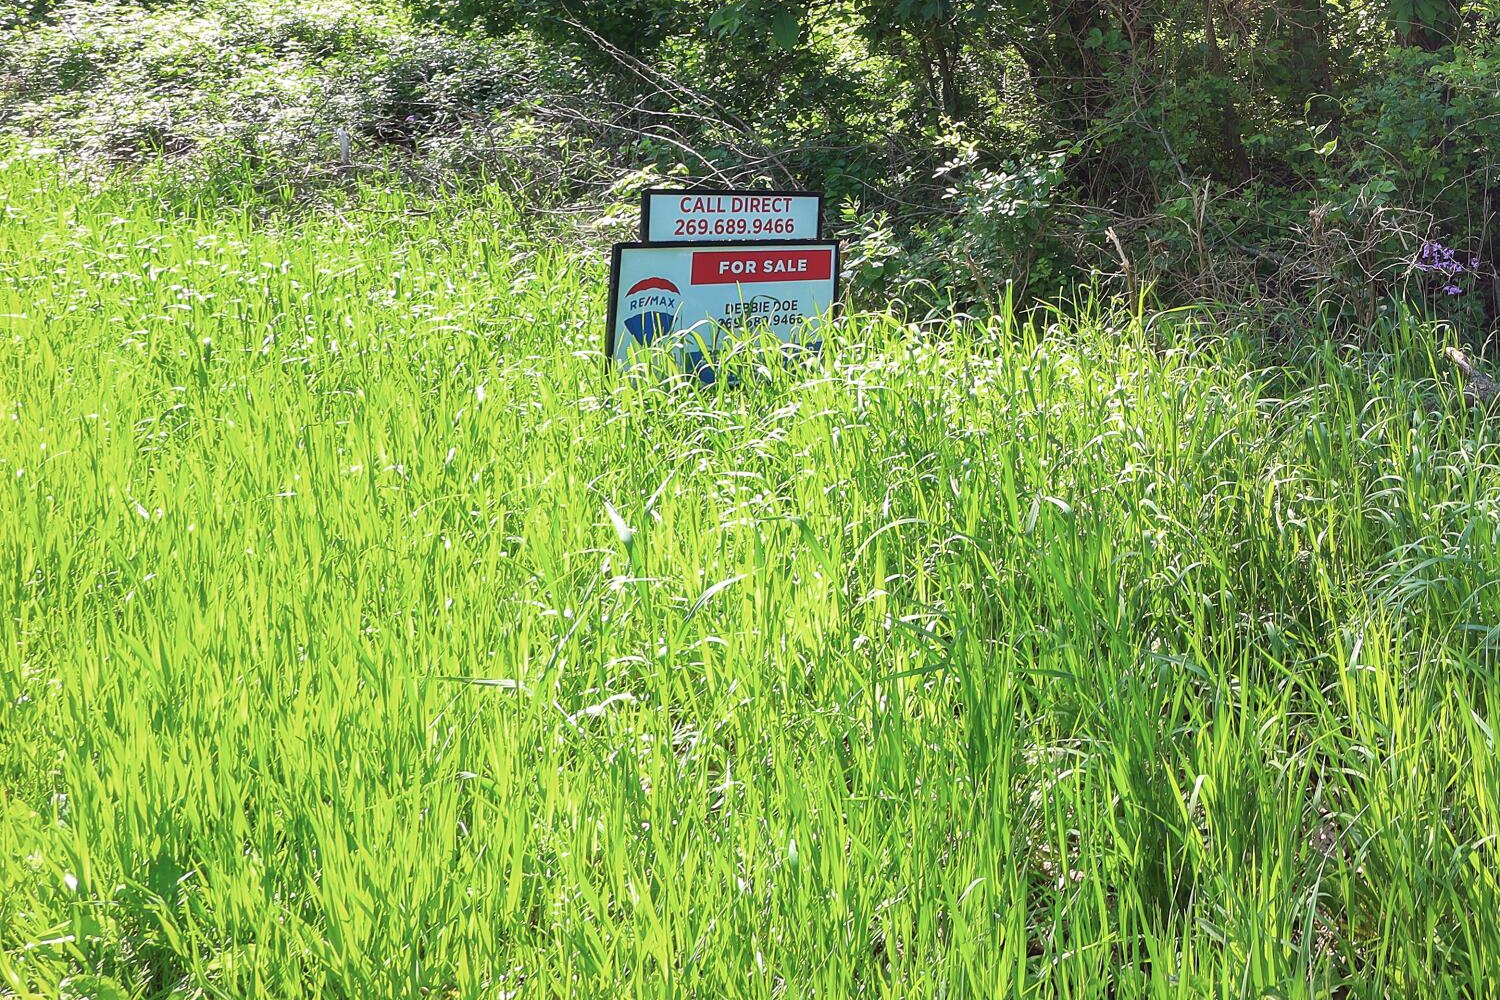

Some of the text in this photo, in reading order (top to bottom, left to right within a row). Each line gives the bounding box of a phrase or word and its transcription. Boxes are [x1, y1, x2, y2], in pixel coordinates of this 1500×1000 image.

[680, 196, 793, 213] CALL DIRECT
[674, 218, 794, 236] 269.689.9466
[719, 259, 808, 275] FOR SALE
[630, 295, 675, 311] RE/MAX
[725, 299, 798, 315] DEBBIE DOE
[717, 313, 804, 329] 269689.9466
